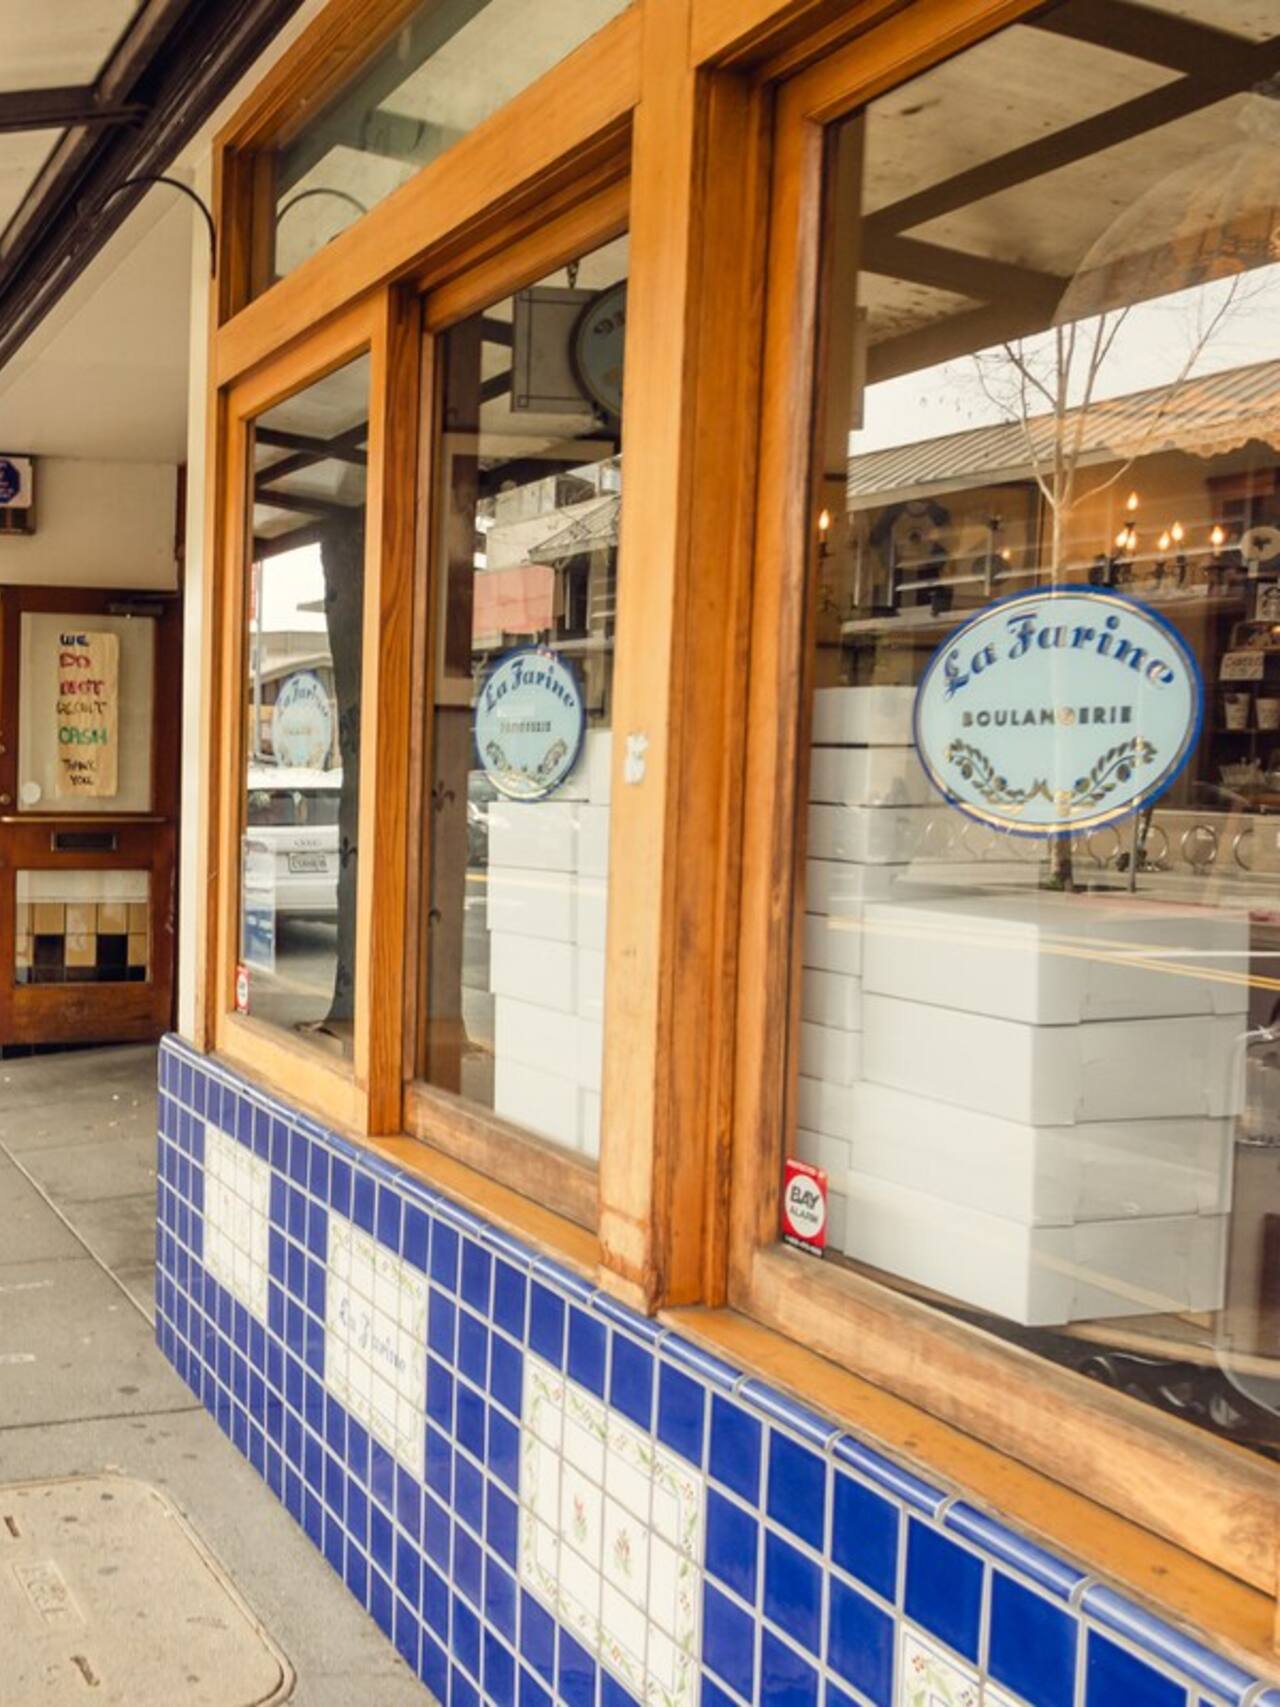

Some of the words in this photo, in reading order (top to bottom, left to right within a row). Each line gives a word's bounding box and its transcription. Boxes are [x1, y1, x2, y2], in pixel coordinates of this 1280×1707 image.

[60, 633, 89, 647] WE
[943, 642, 998, 702] La
[1006, 610, 1176, 690] Farine
[485, 678, 507, 714] La
[511, 659, 576, 708] Farine
[58, 726, 108, 746] CASH
[791, 1185, 820, 1210] BAY
